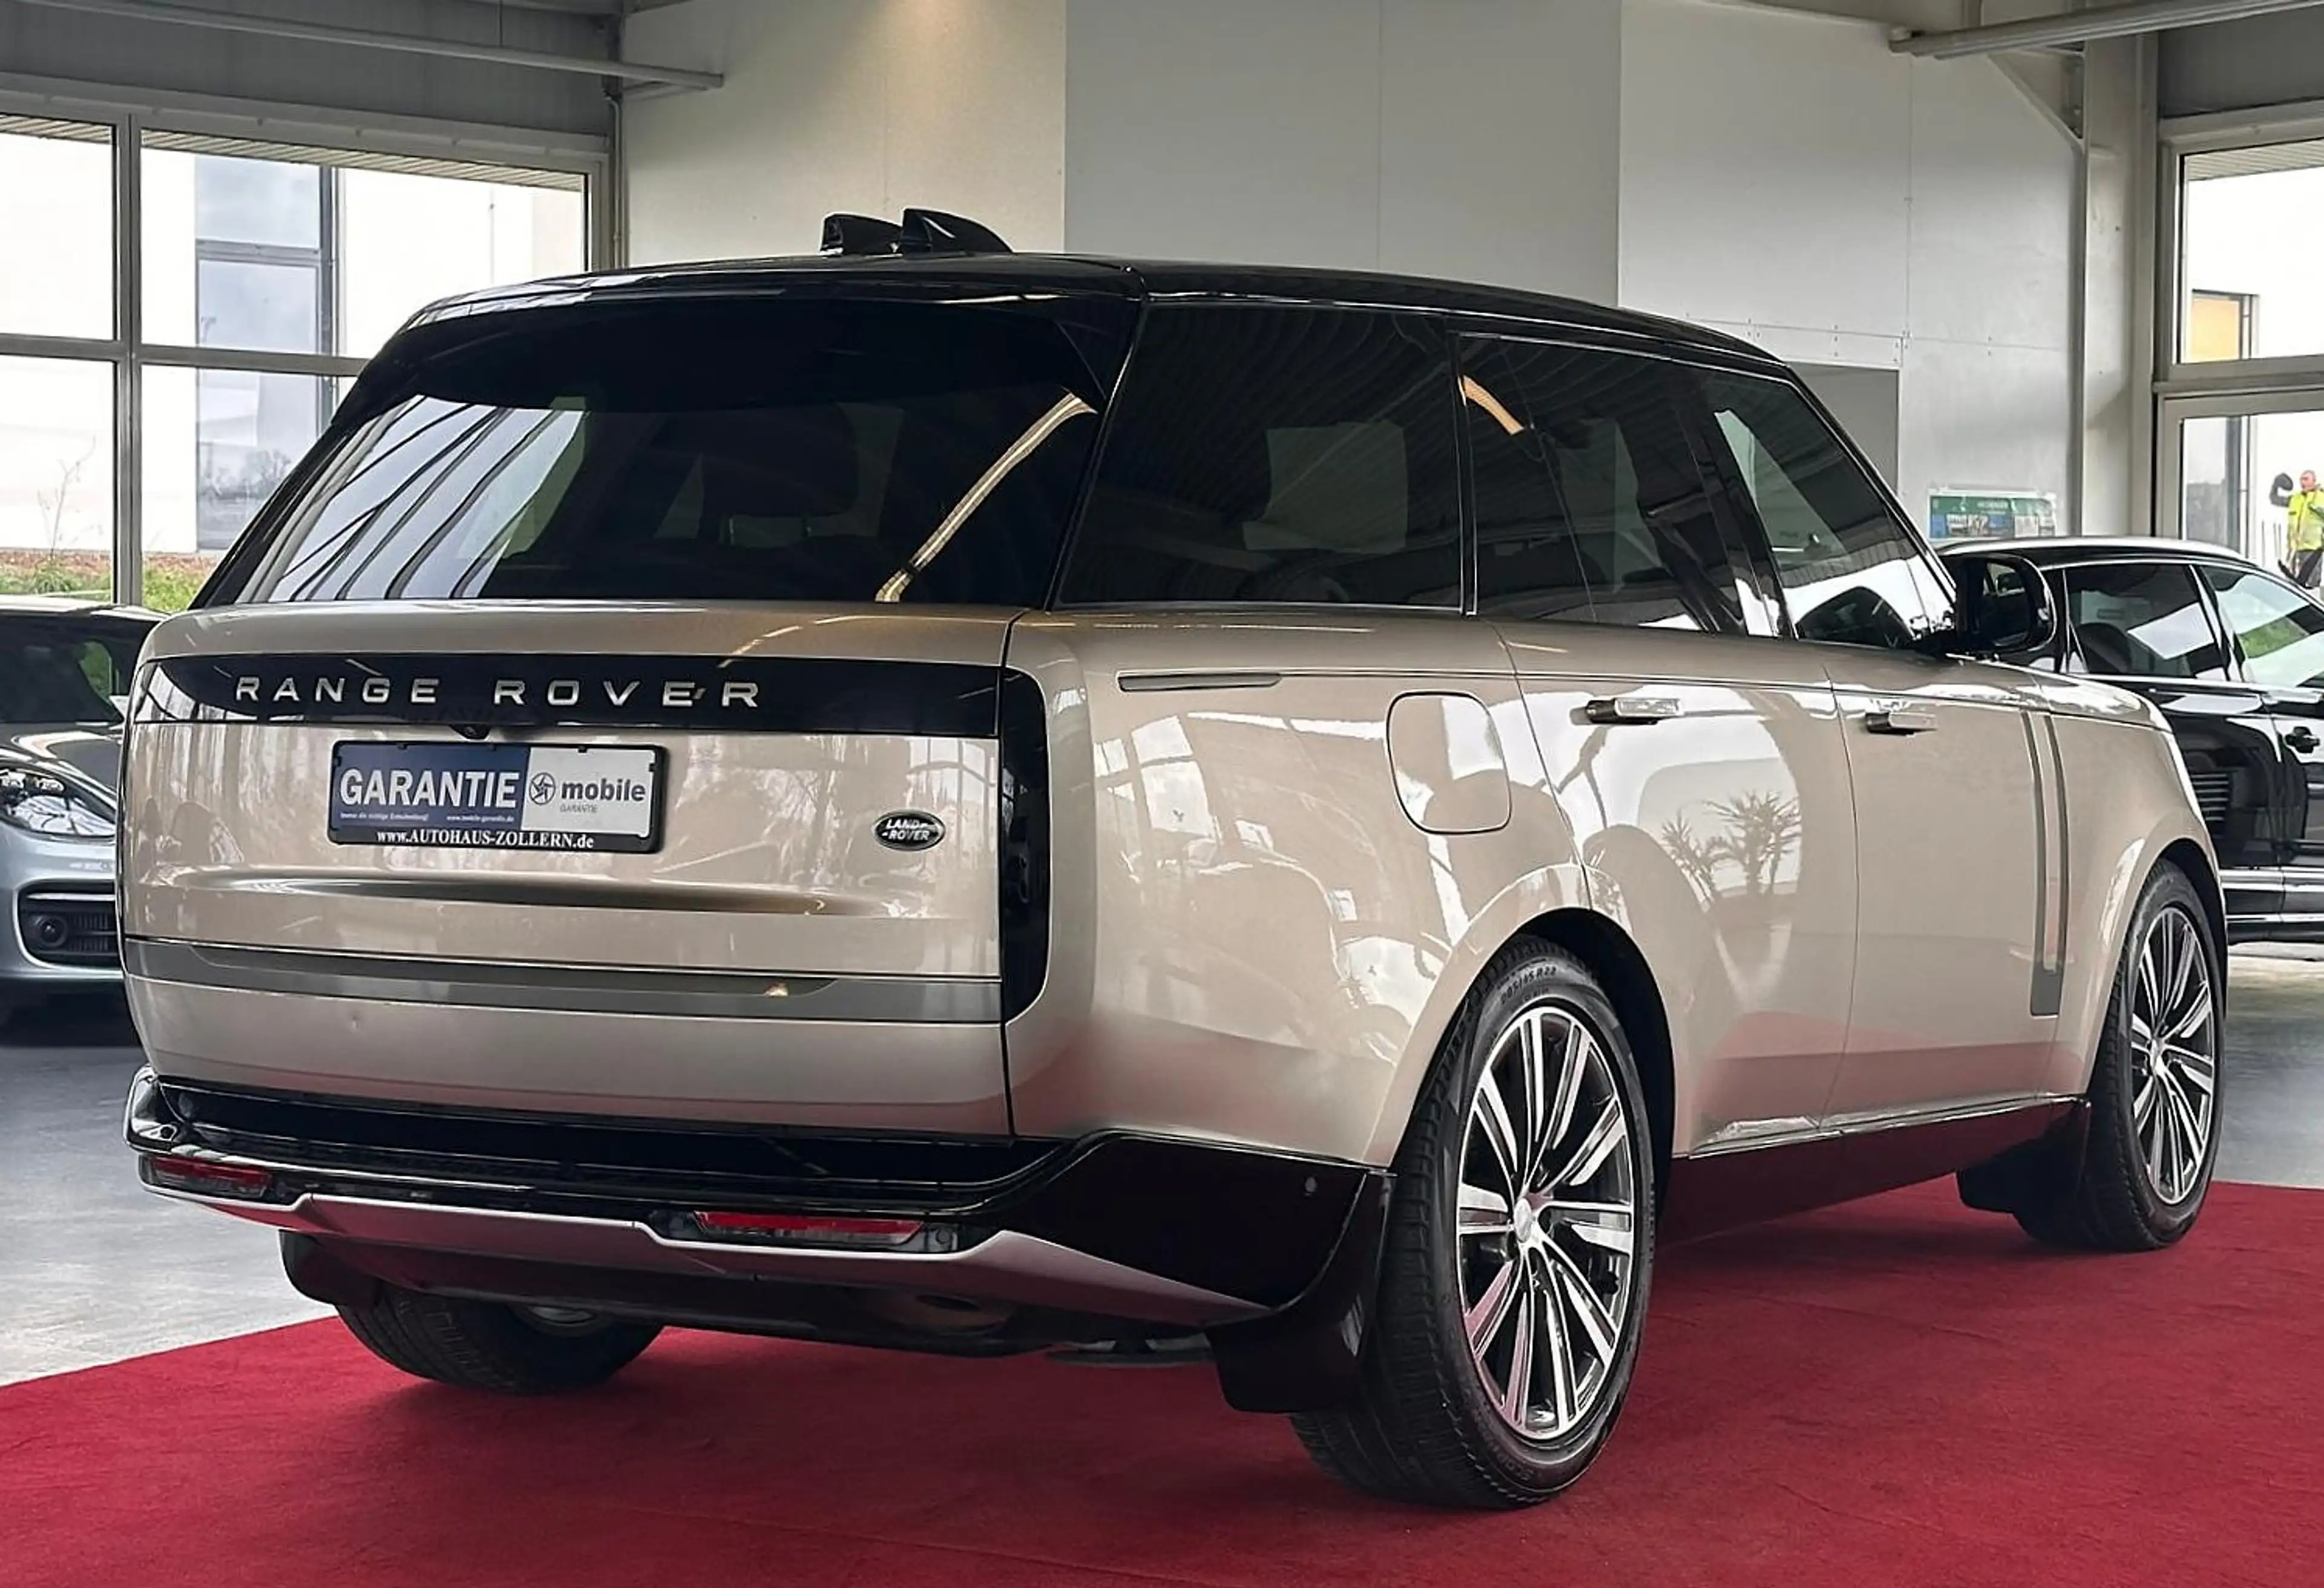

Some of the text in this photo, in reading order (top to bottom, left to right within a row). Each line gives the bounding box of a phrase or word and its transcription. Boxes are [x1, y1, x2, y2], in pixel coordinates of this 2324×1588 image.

[236, 677, 759, 707] RANGE ROVER
[340, 768, 519, 808] GARANTIE
[561, 778, 646, 802] mobile
[376, 828, 594, 848] www.AUTOHAUS-ZOLLERN.de
[888, 830, 930, 841] ROVER
